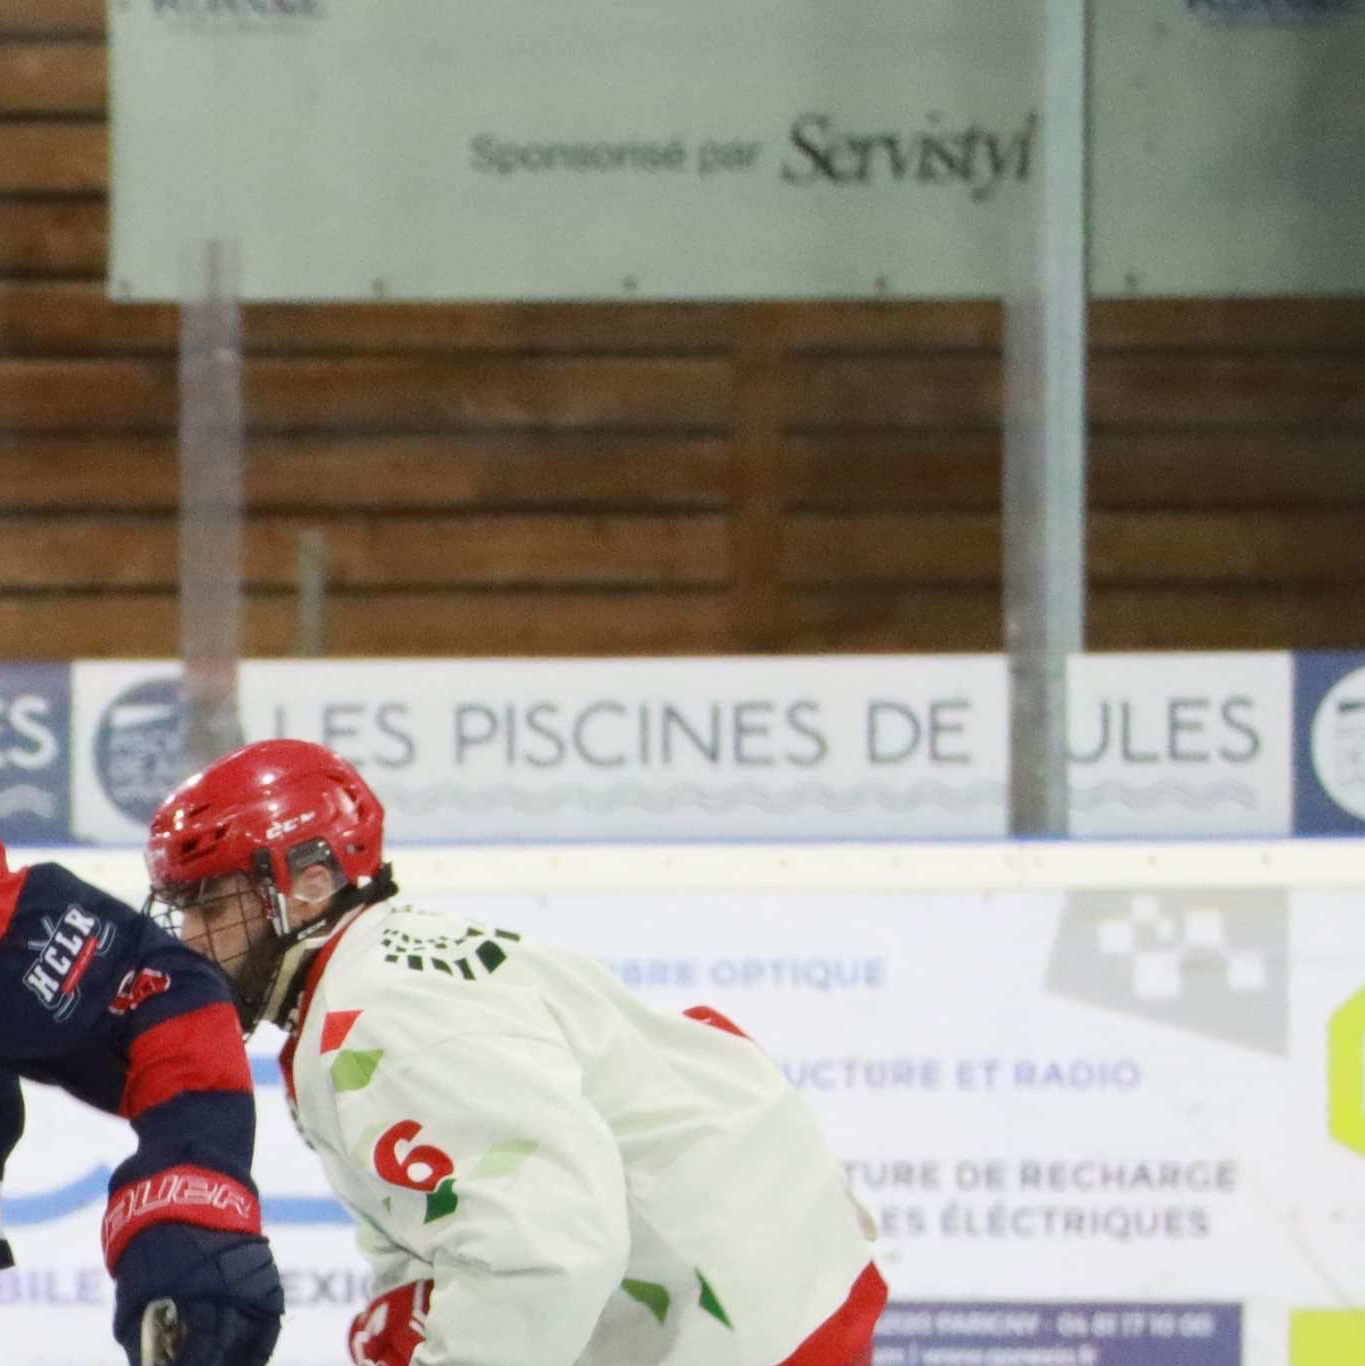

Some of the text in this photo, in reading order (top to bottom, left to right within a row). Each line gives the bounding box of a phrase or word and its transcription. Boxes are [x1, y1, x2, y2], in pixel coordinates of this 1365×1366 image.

[471, 112, 1040, 202] Sponsorisé par Servistyl
[455, 698, 829, 769] PISCINES
[869, 698, 972, 768] DE
[1067, 695, 1261, 764] ULES
[27, 908, 96, 1003] HCLR
[709, 957, 886, 991] OPTIQUE
[783, 1057, 1142, 1091] UCTURE ET RADIO
[374, 1120, 455, 1193] 6
[955, 1158, 1007, 1192] DE
[1020, 1158, 1238, 1192] RECHARGE
[880, 1206, 927, 1239] ES
